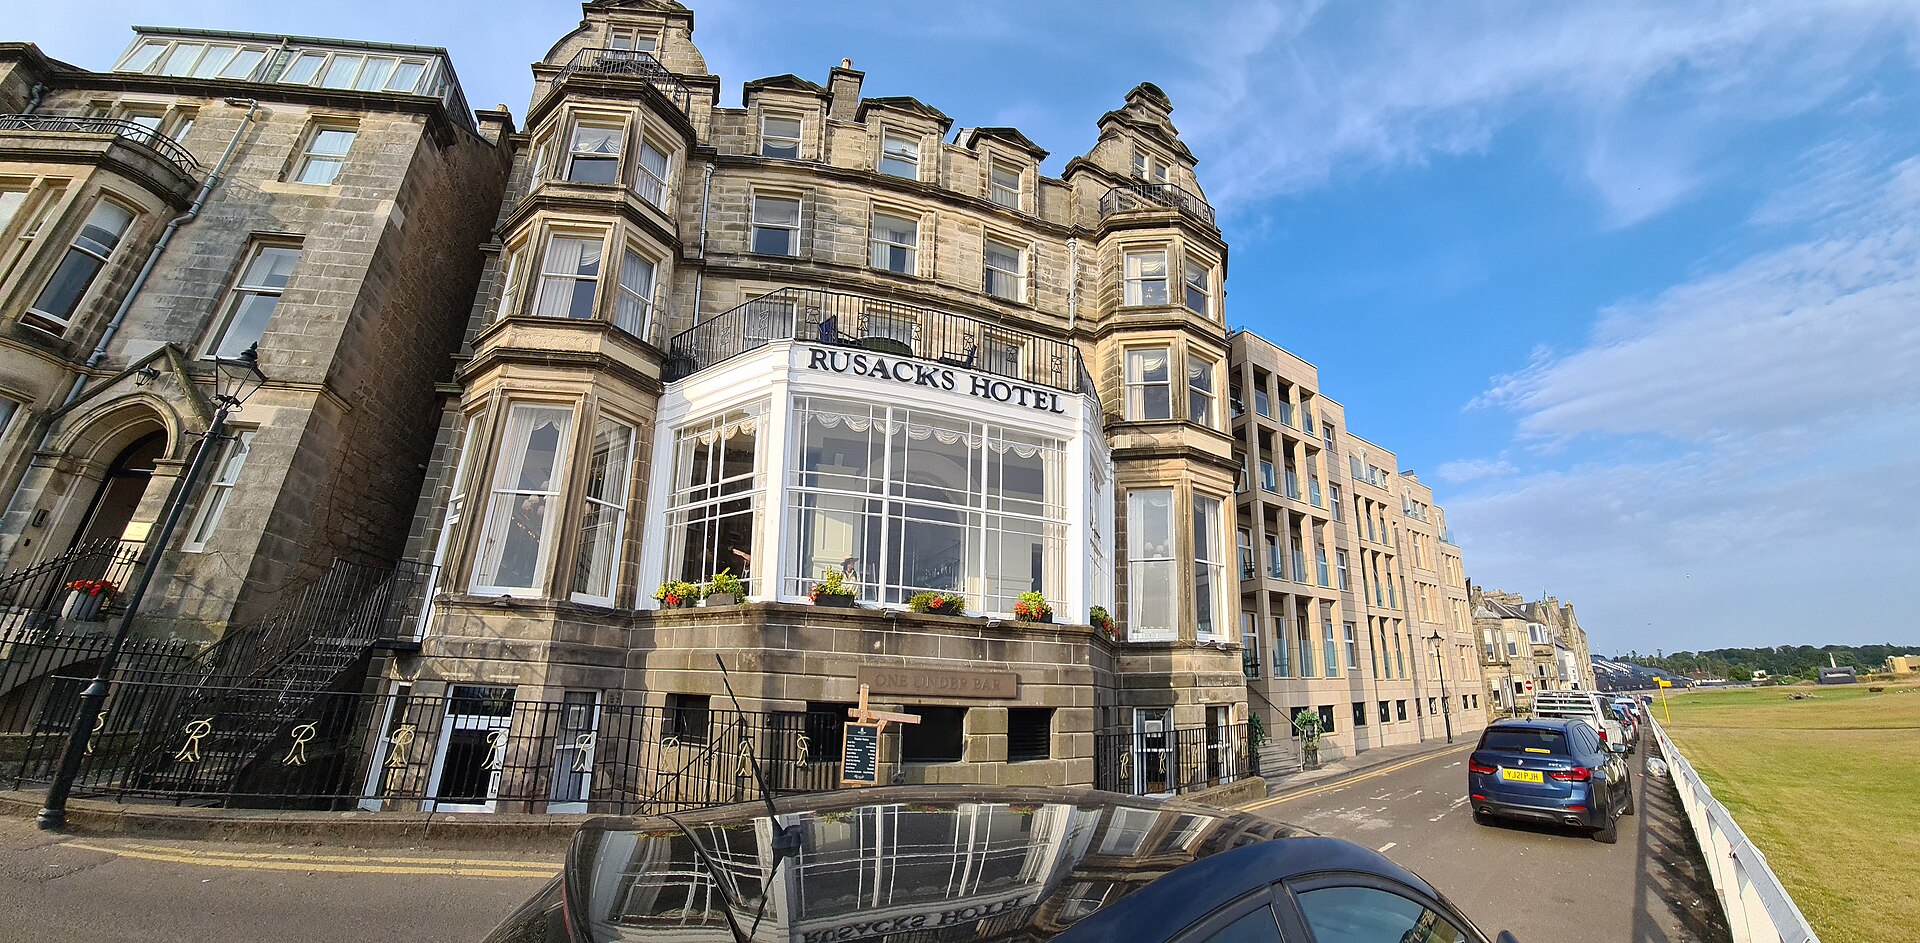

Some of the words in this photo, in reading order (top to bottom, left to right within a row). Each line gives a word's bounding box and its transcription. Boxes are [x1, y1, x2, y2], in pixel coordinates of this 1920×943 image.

[808, 347, 955, 390] RUSACKS
[969, 375, 1064, 414] HOTEL
[874, 673, 908, 687] ONE
[913, 675, 967, 690] UNDER
[972, 678, 1001, 691] BAR
[1506, 770, 1522, 780] YJ21
[1523, 772, 1539, 781] PJH
